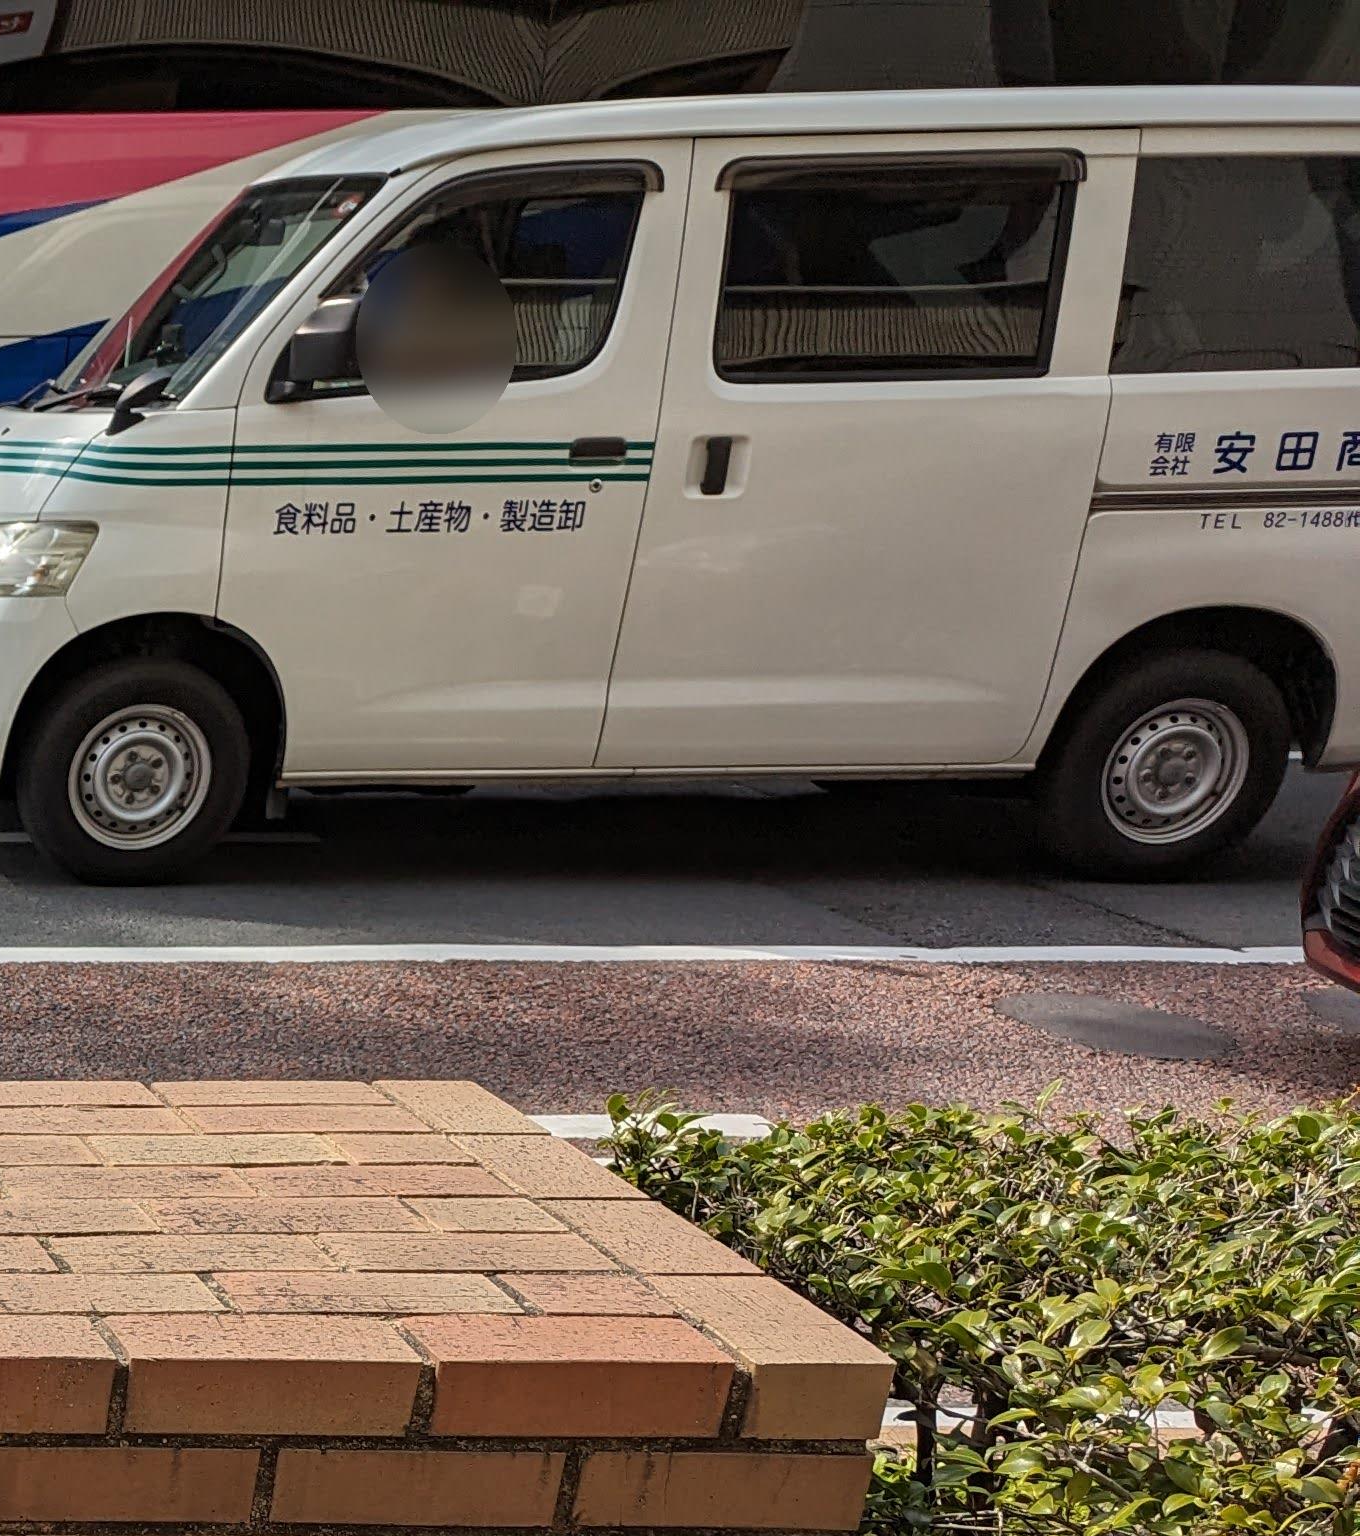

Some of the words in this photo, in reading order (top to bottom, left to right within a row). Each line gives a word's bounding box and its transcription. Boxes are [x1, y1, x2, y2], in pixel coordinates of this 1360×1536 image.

[1154, 433, 1195, 453] 有限
[1149, 456, 1190, 476] 会社
[273, 500, 585, 535] 食料品・土産物・製造卸
[1200, 514, 1242, 529] TEL
